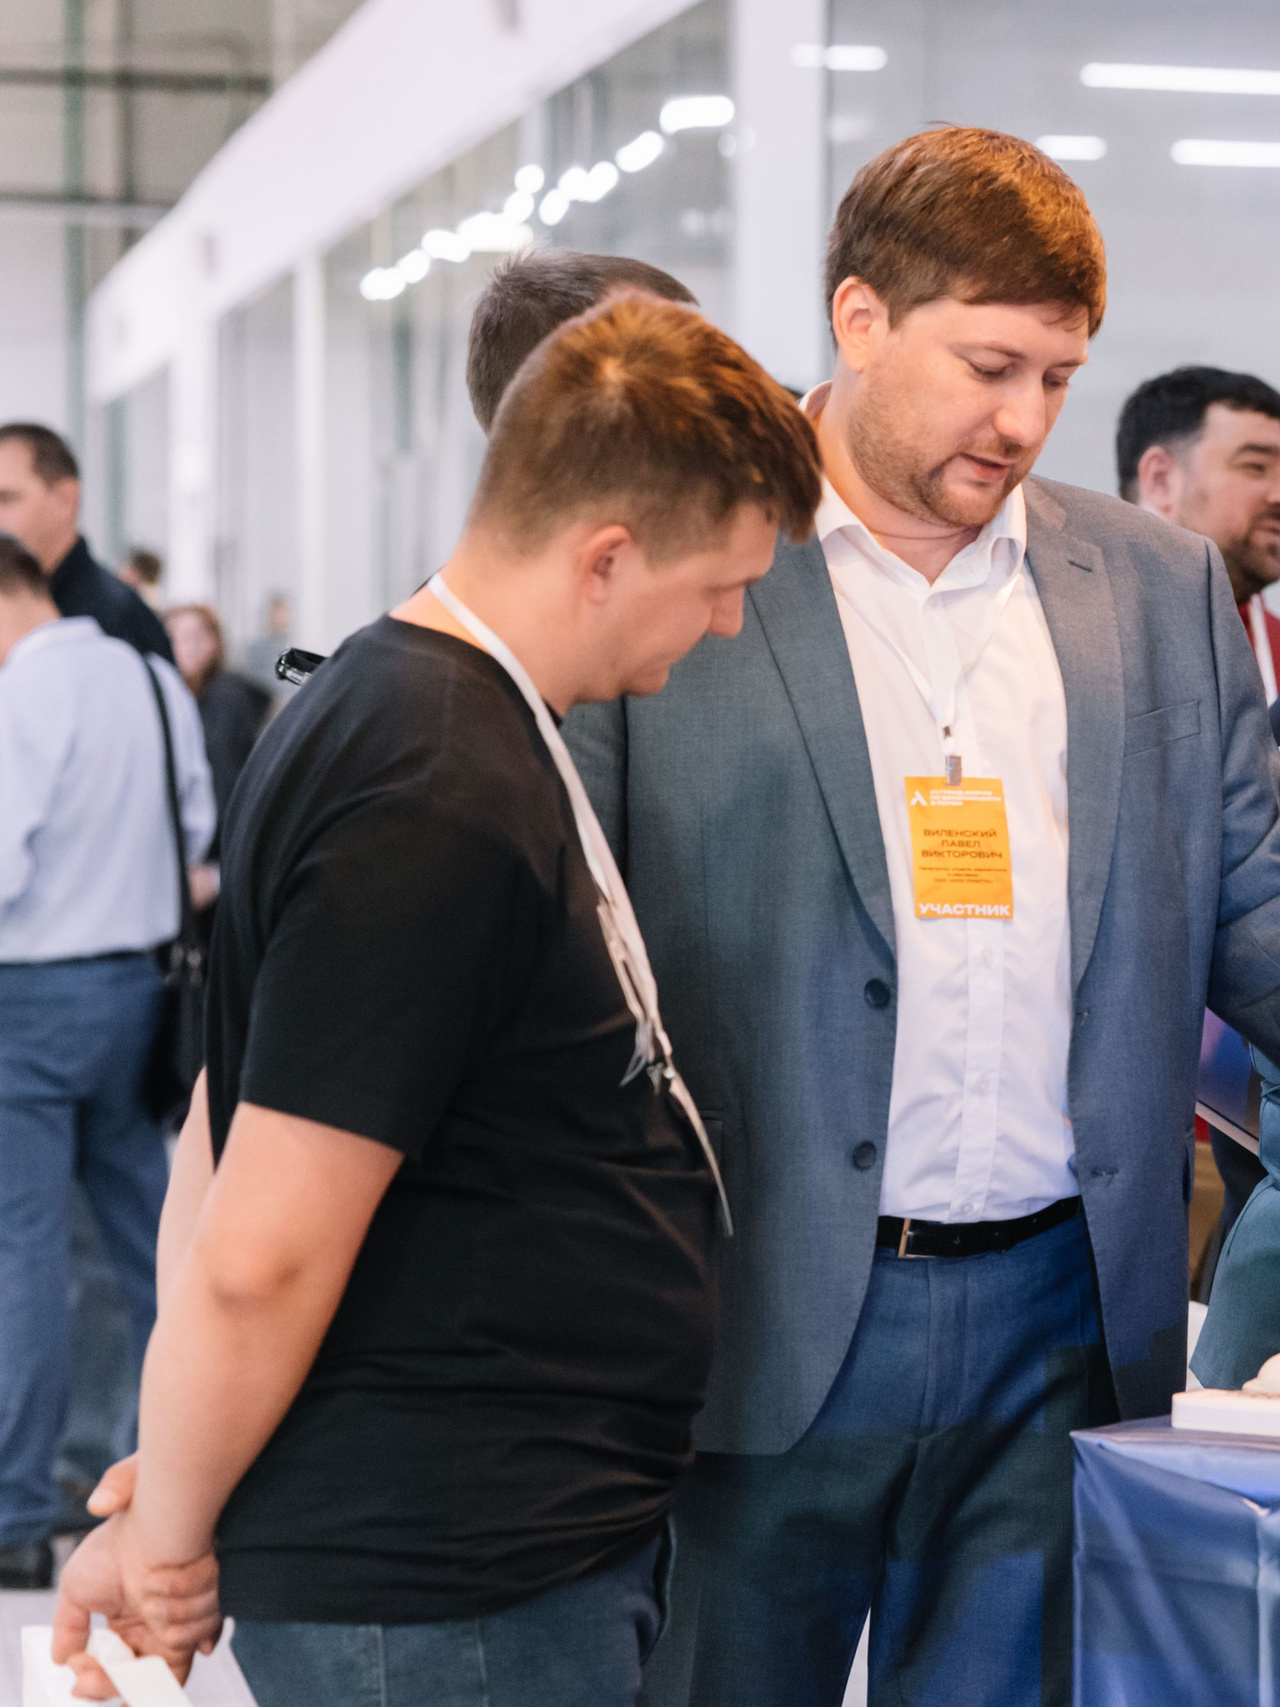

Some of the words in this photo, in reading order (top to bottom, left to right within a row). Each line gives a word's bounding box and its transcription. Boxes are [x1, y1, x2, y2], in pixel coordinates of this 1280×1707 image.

[923, 828, 998, 838] ВИЛЕНСКИЙ
[941, 840, 981, 848] ПАВЕЛ
[921, 849, 1003, 859] ВИКТОРОВИЧ
[918, 903, 1011, 917] УЧАСТНИК
